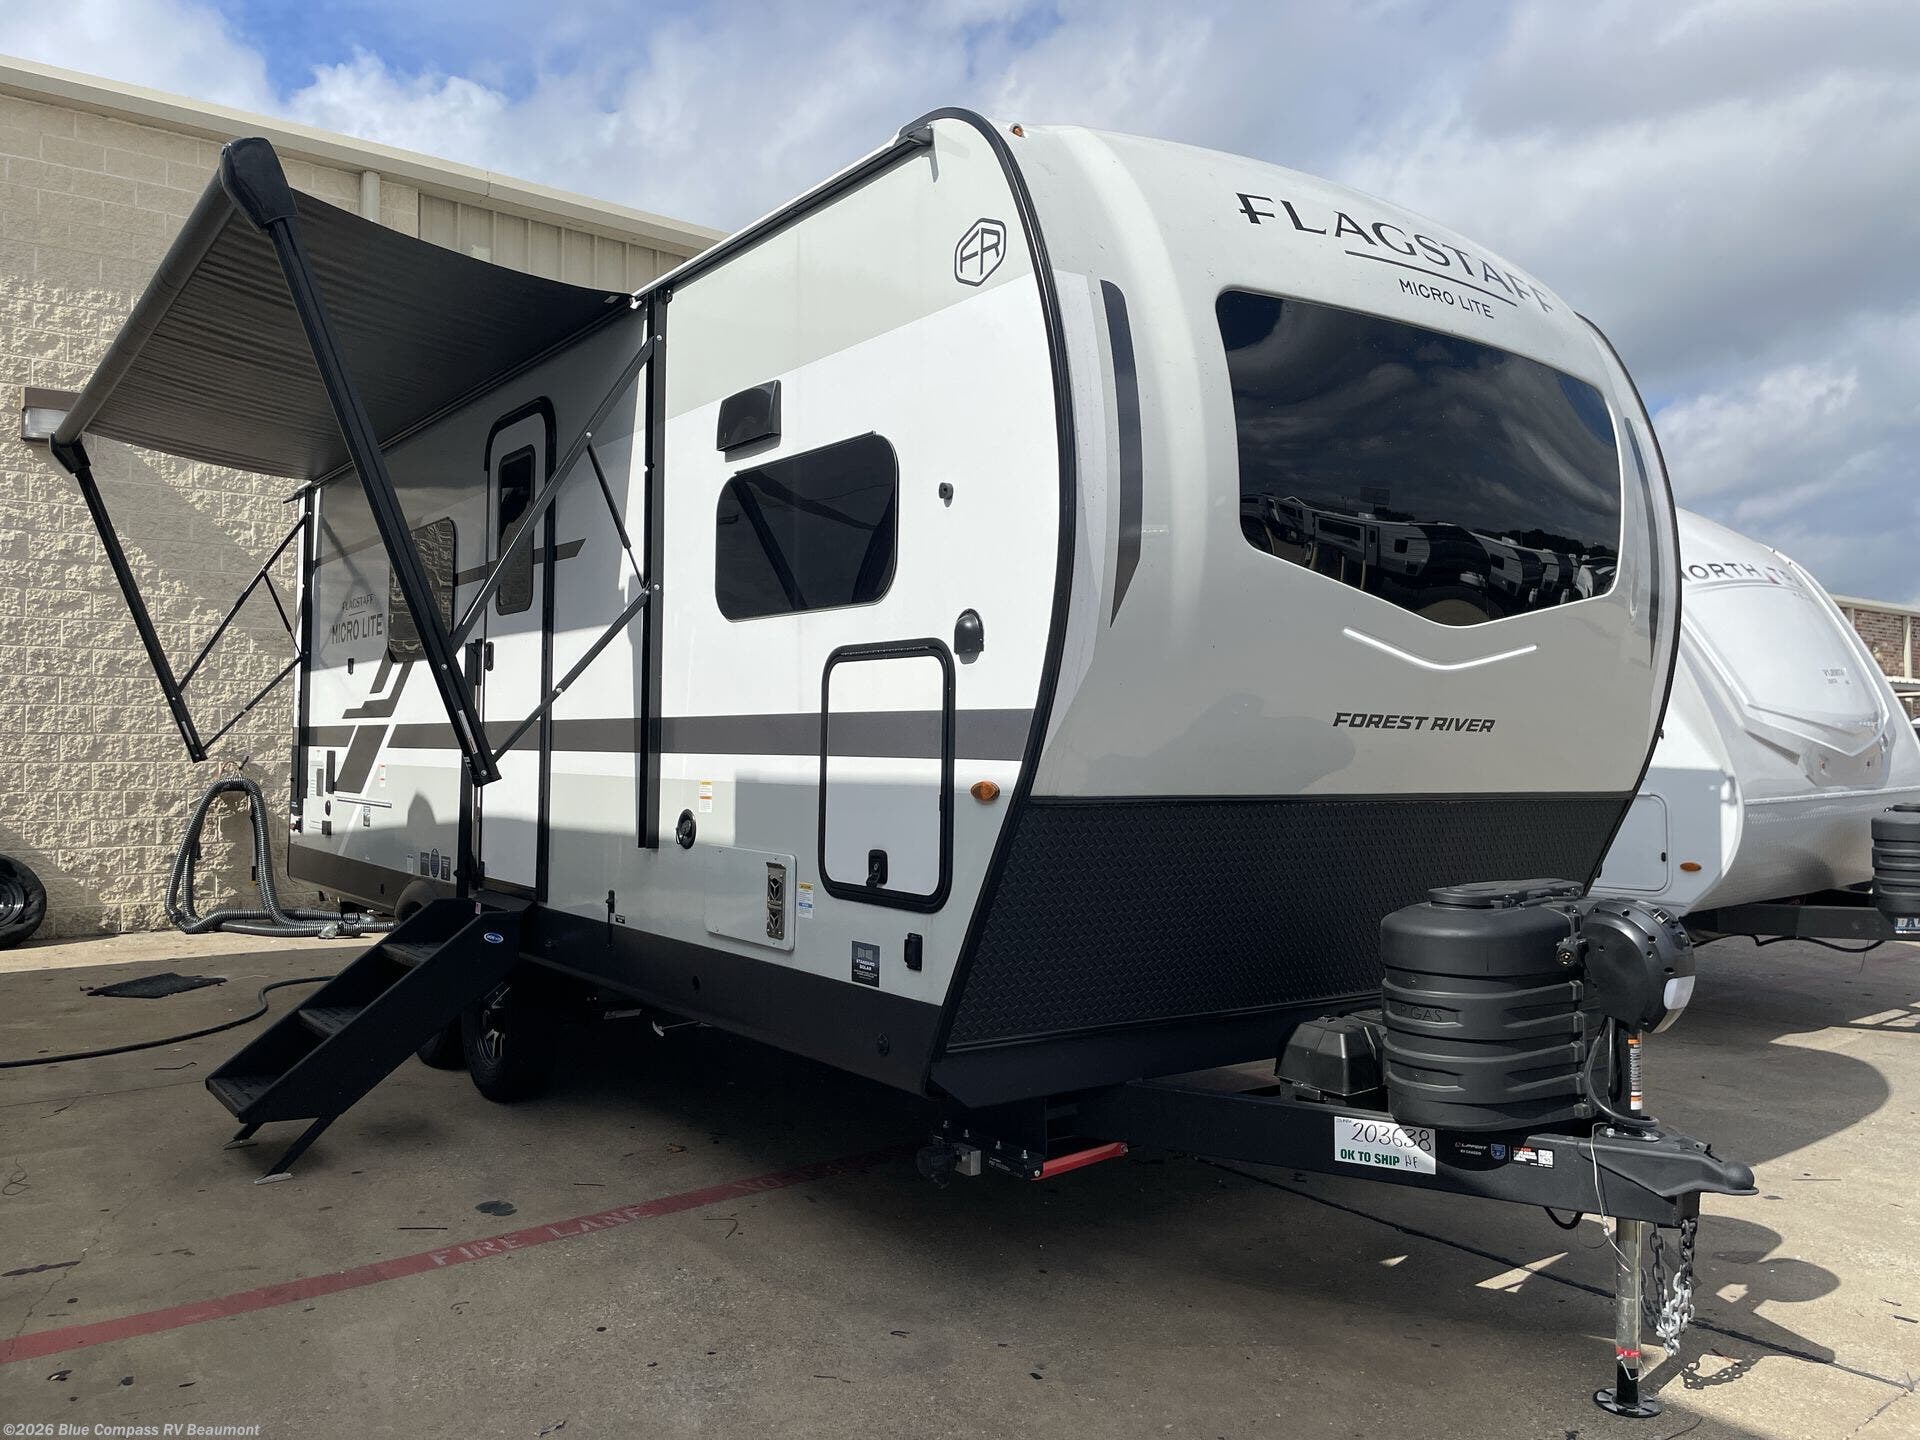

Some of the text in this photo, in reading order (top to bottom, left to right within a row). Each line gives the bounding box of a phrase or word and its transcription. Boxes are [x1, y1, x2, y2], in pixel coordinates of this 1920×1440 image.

[1235, 192, 1554, 313] FLAGSTAFF
[1398, 278, 1495, 319] MICRO LITE
[331, 613, 383, 644] MICRO LITE
[1332, 712, 1496, 733] FOREST RIVER
[1410, 1006, 1442, 1022] GAS
[1351, 1122, 1431, 1152] 203638
[1340, 1148, 1400, 1166] OK TO SHIP
[430, 1233, 523, 1266] FIRE
[549, 1204, 653, 1239] LANE
